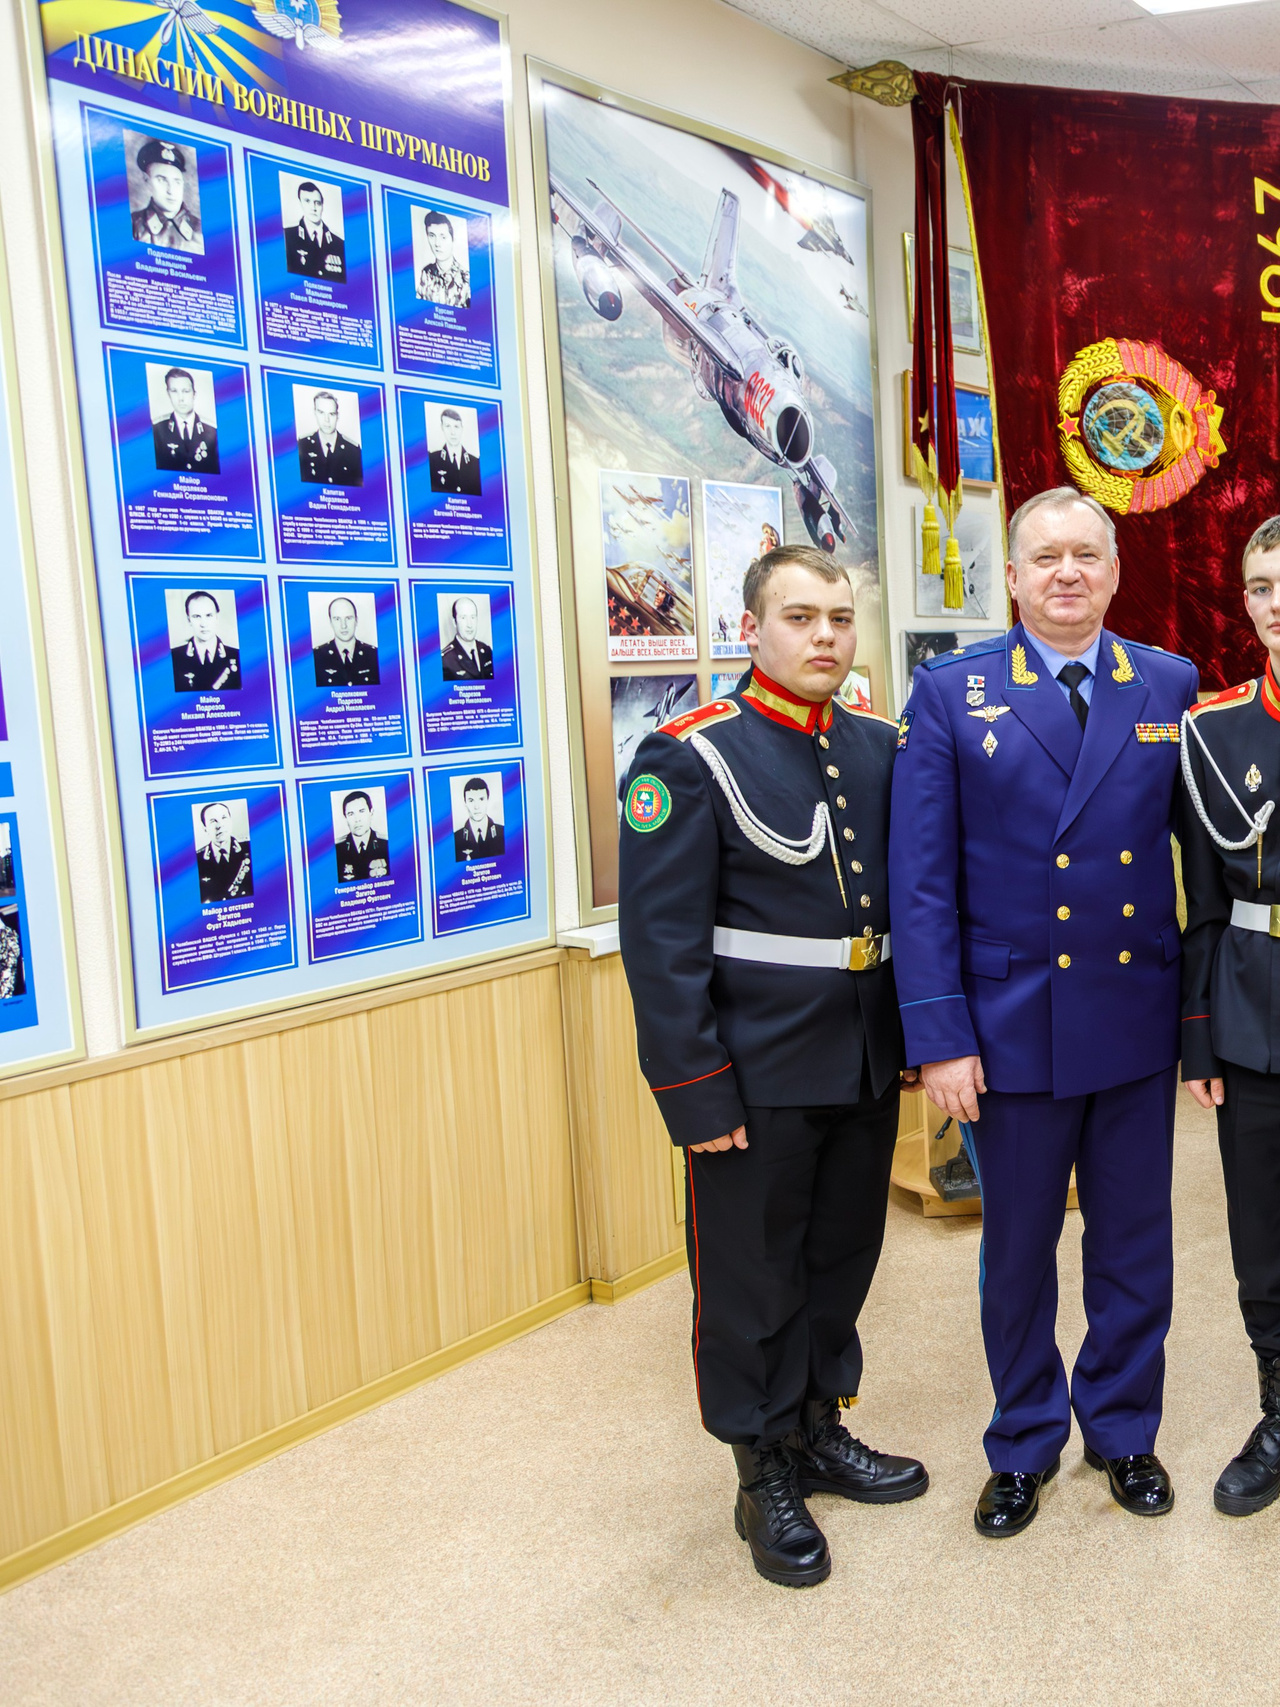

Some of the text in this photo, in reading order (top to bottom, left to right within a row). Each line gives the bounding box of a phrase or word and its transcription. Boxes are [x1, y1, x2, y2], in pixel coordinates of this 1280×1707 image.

[72, 31, 491, 183] ДИНАСТИИ ВОЕННЫХ ШТУРМАНОВ
[147, 247, 193, 264] Подполковник
[155, 257, 187, 271] Малышев
[135, 261, 207, 282] Владимир Васильевич
[308, 296, 348, 310] Владимирович
[179, 475, 201, 486] Майор
[153, 490, 184, 500] Геннадий
[620, 639, 645, 647] ЛЕТАТЬ
[648, 639, 667, 647] ВЫШЕ
[611, 648, 635, 657] ДАЛЬШЕ
[653, 648, 679, 656] БЫСТРЕЕ
[199, 696, 220, 704] Майор
[181, 711, 241, 720] Михаил Алексеевич
[334, 883, 373, 895] Генерал-майор
[340, 898, 366, 908] Владимир
[202, 907, 222, 917] Майор
[228, 902, 254, 912] отставке
[216, 911, 241, 921] Загитов
[206, 922, 222, 931] Фуат
